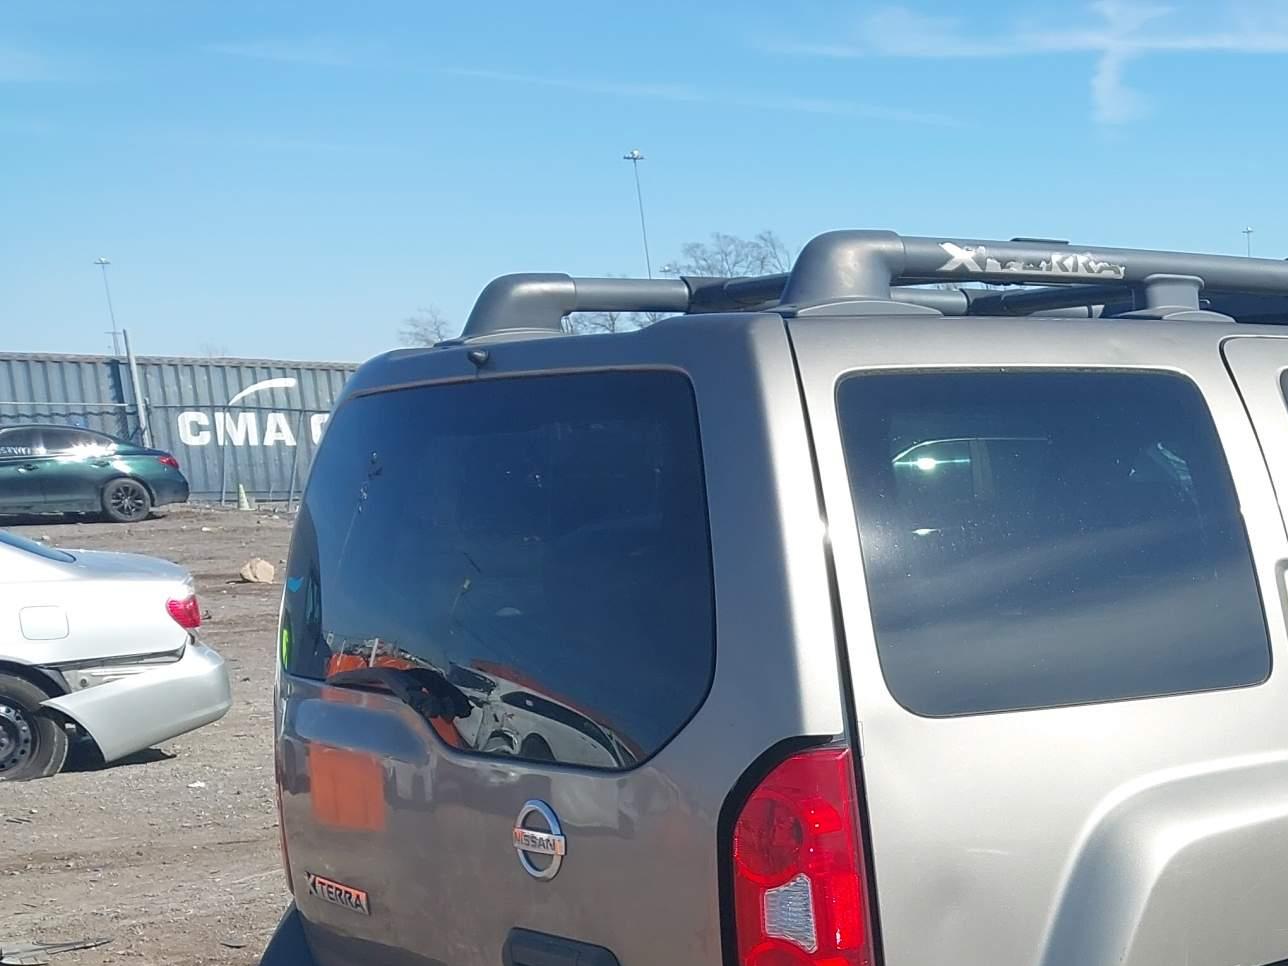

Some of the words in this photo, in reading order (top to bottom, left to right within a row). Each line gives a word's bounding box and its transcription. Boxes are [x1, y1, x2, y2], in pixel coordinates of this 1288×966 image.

[177, 411, 297, 447] CMA
[514, 830, 558, 851] NISSAN
[303, 870, 368, 913] XTERRA
